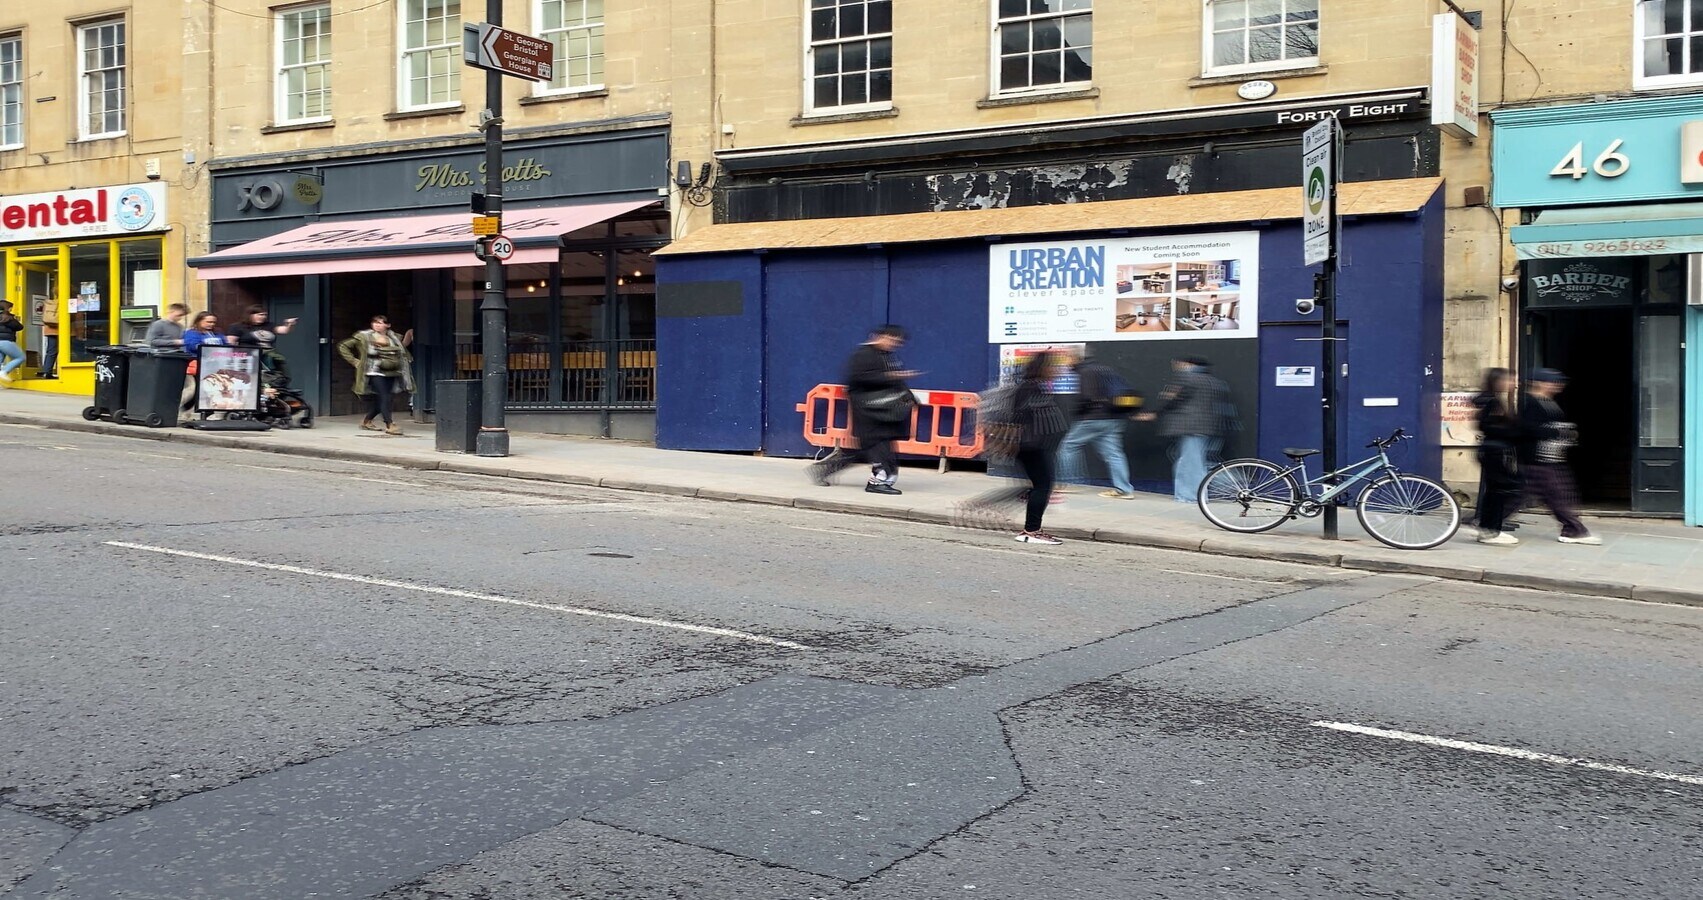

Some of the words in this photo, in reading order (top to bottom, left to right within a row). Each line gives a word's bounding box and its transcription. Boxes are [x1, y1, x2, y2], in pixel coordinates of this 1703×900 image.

[513, 43, 539, 57] Bristol
[516, 36, 549, 51] George's
[503, 51, 537, 66] Georgian
[508, 60, 532, 73] House
[1459, 48, 1475, 70] BARBER
[1461, 67, 1473, 86] SHOP
[1277, 109, 1341, 124] FORTY
[1349, 103, 1408, 117] EIGHT
[1306, 154, 1320, 168] Clean
[1320, 149, 1328, 160] air
[1549, 138, 1630, 179] 46
[415, 162, 475, 192] Mrs.
[434, 187, 485, 198] CHOCOLAT
[504, 184, 531, 192] OUSE
[2, 189, 108, 230] ental
[1308, 216, 1325, 234] ZONE
[494, 242, 512, 254] 20
[1171, 241, 1231, 250] Accommodation
[1537, 243, 1573, 255] 0117
[1584, 239, 1667, 253] 9265622
[1009, 245, 1105, 272] URBAN
[1009, 266, 1104, 290] CREATION
[1532, 272, 1631, 289] BARBER
[1008, 290, 1053, 298] clever
[1062, 288, 1105, 297] space
